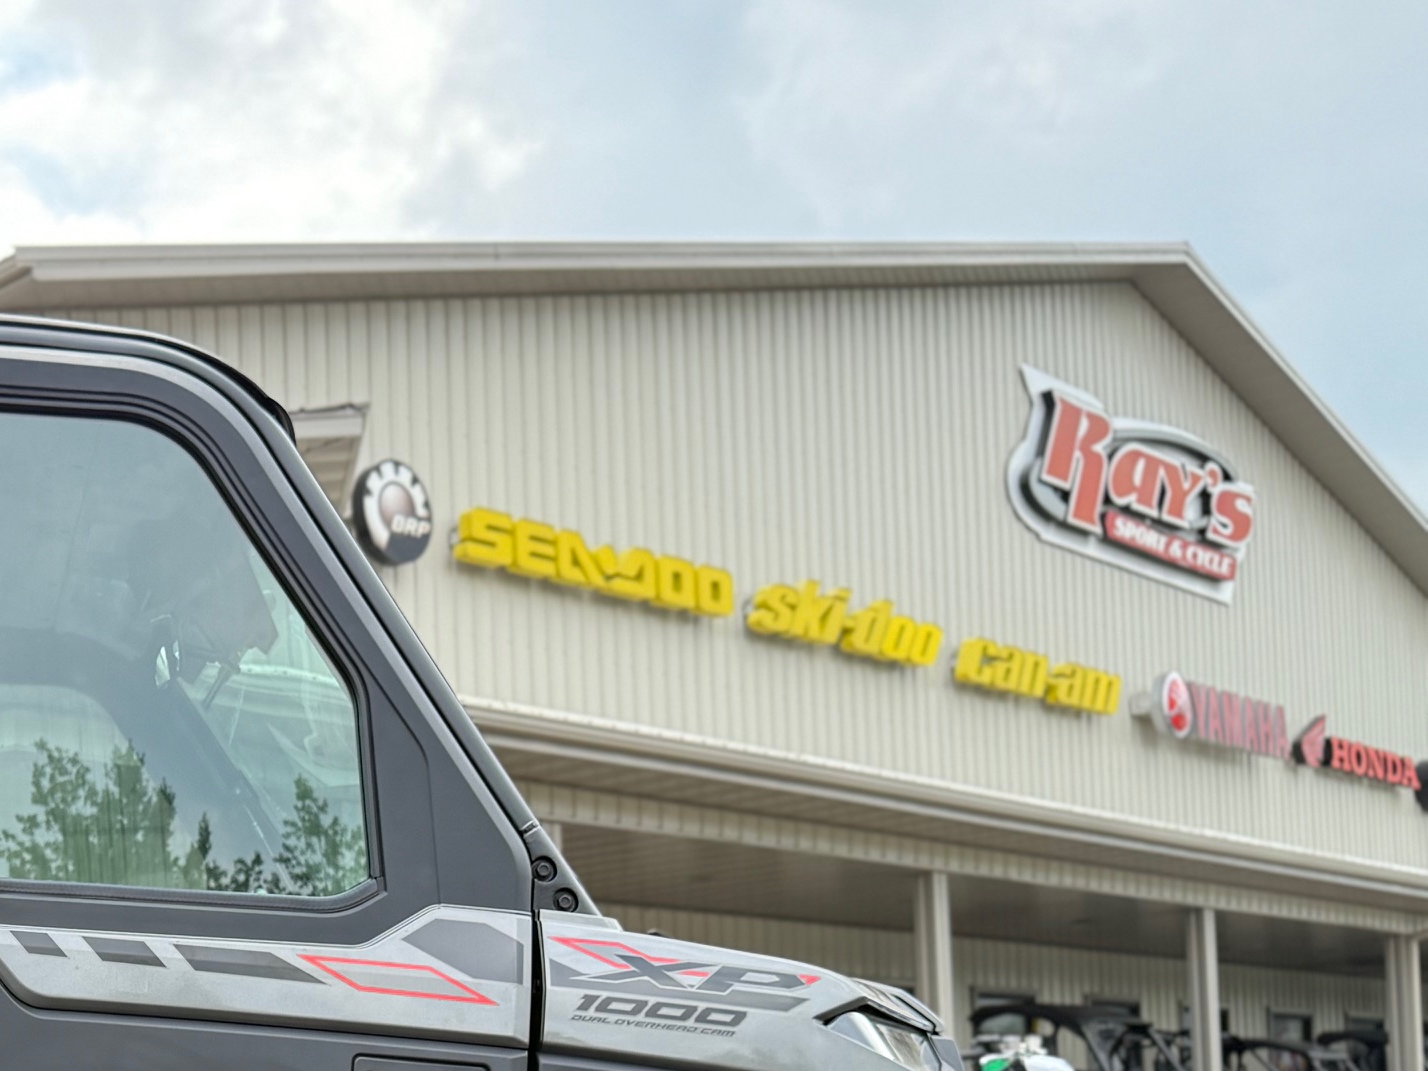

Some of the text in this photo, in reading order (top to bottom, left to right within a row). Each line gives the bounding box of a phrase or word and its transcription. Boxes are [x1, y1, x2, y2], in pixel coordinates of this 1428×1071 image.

[1113, 515, 1233, 577] SPORT & CYCLE
[1188, 681, 1291, 760] YAMAHA
[1328, 735, 1422, 791] HONDA
[570, 953, 809, 995] XP
[570, 1014, 737, 1038] DUAL OVERHEAD CAM
[575, 994, 748, 1028] 1000
